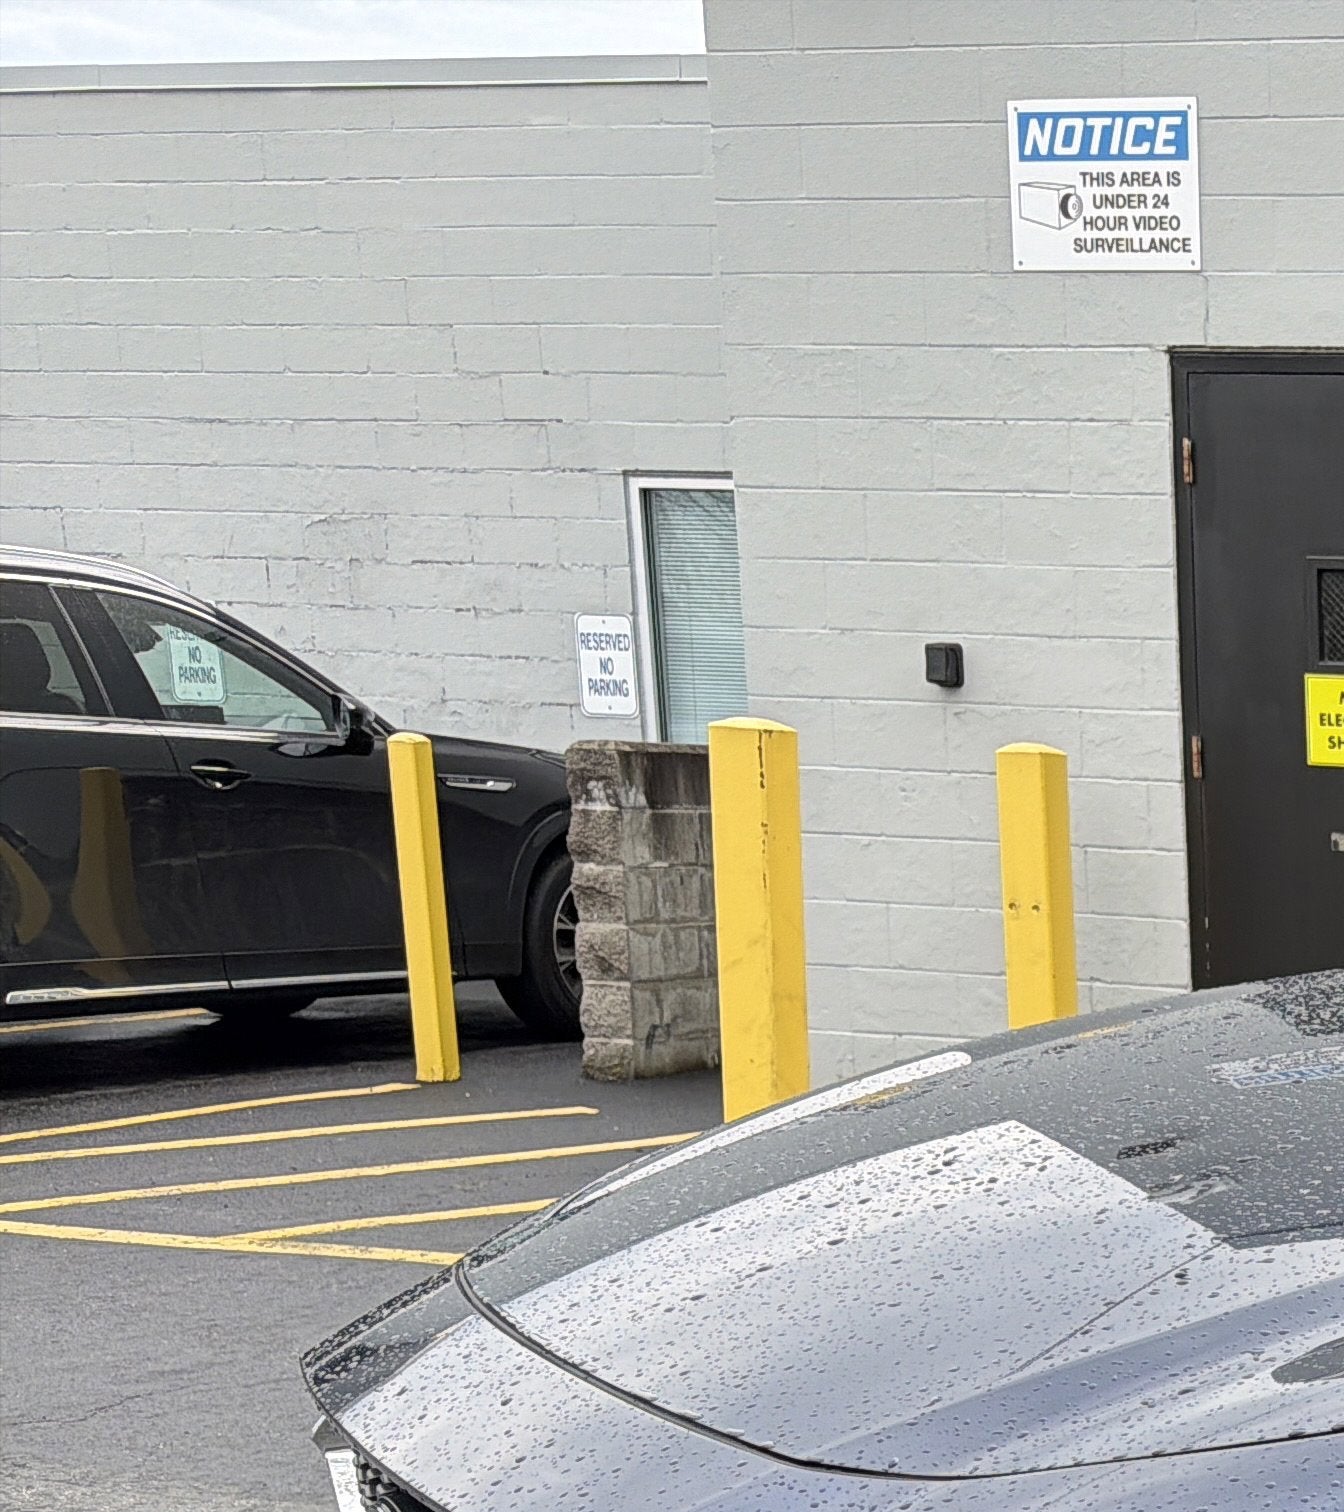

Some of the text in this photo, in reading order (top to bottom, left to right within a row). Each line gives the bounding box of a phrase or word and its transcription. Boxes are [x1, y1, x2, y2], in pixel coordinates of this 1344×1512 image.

[1023, 117, 1182, 156] NOTICE
[1079, 171, 1181, 187] THIS AREA IS
[1093, 194, 1170, 209] UNDER 24
[1083, 215, 1181, 231] HOUR VIDEO
[1073, 237, 1192, 253] SURVEILLANCE
[580, 632, 631, 652] RESERVED
[187, 645, 202, 664] NO
[178, 666, 217, 685] PARKING
[599, 656, 614, 676] NO
[588, 678, 630, 698] PARKING
